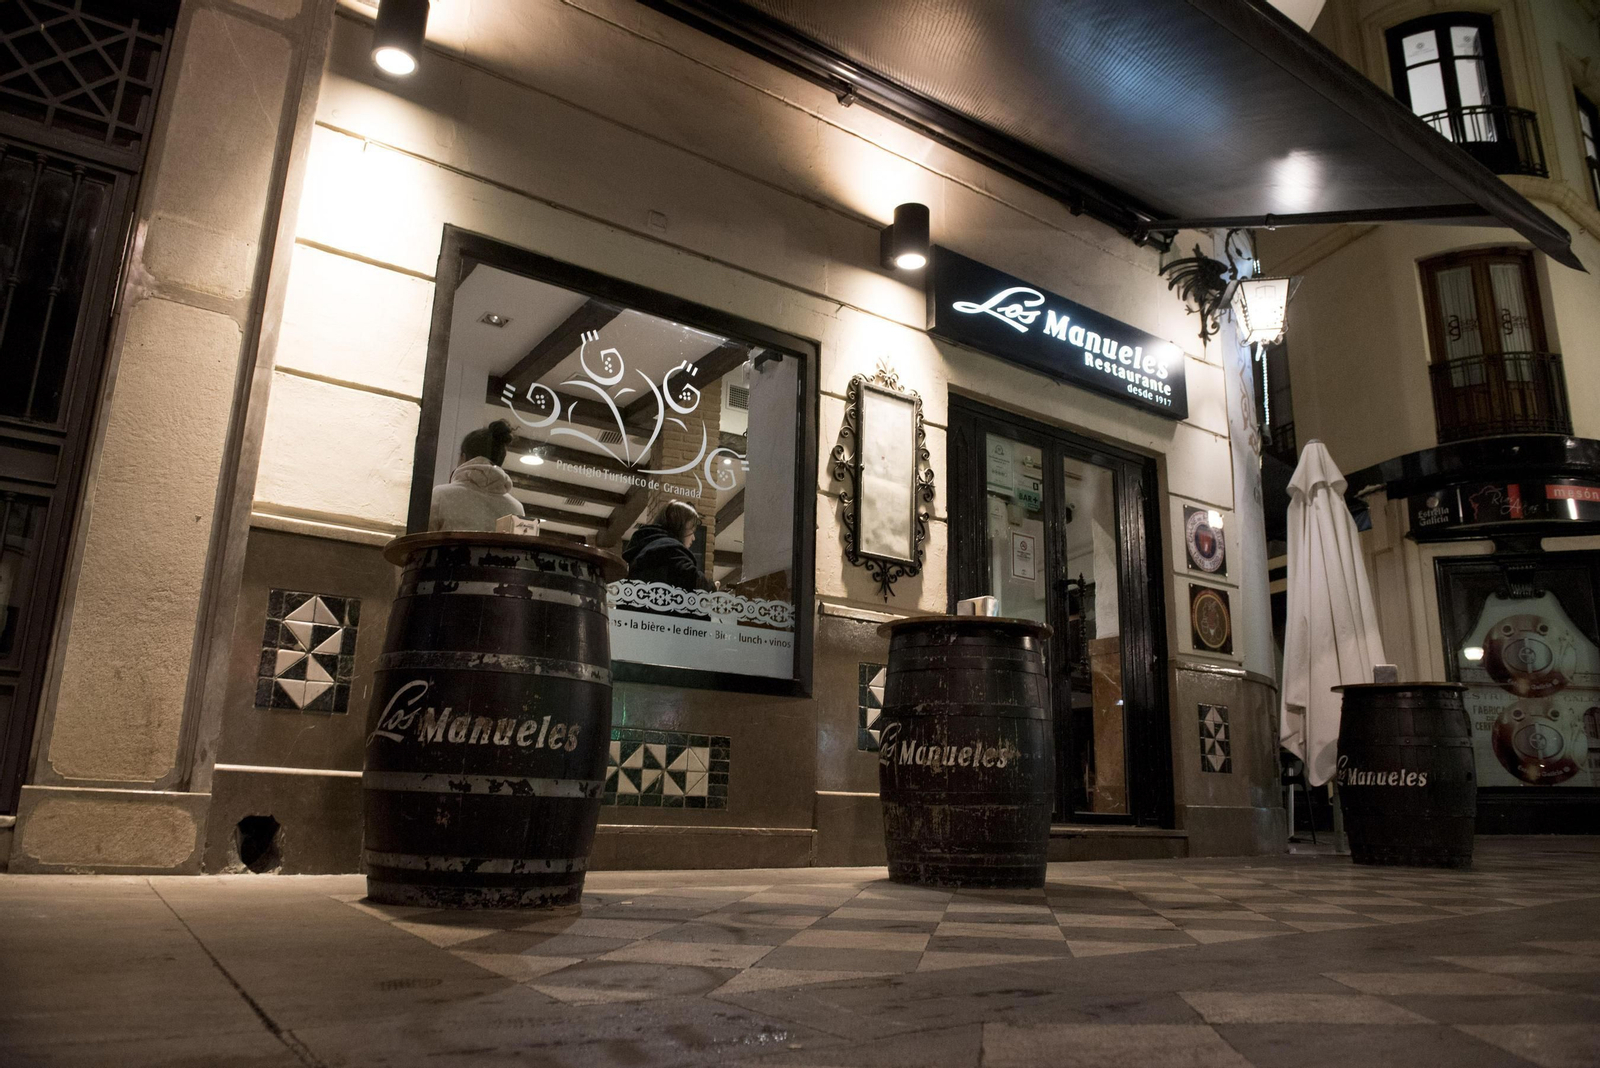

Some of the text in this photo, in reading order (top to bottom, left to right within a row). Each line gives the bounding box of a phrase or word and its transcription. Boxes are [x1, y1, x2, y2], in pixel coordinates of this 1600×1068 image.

[952, 286, 1169, 380] Los Manueles
[1084, 351, 1172, 396] Restaurante
[1127, 384, 1171, 407] desde 1917
[556, 459, 602, 479] Prestigio
[648, 479, 660, 491] de
[663, 482, 701, 499] Granada
[1553, 487, 1599, 500] mesón
[1418, 507, 1450, 520] Estrella
[1419, 515, 1449, 526] Galicia
[630, 618, 638, 630] la
[641, 619, 666, 633] bière
[673, 624, 681, 635] le
[739, 632, 763, 645] lunch
[769, 638, 791, 649] vinos
[365, 679, 582, 752] Los Manueles
[898, 739, 1009, 769] Manueles
[1347, 767, 1428, 787] Manueles
